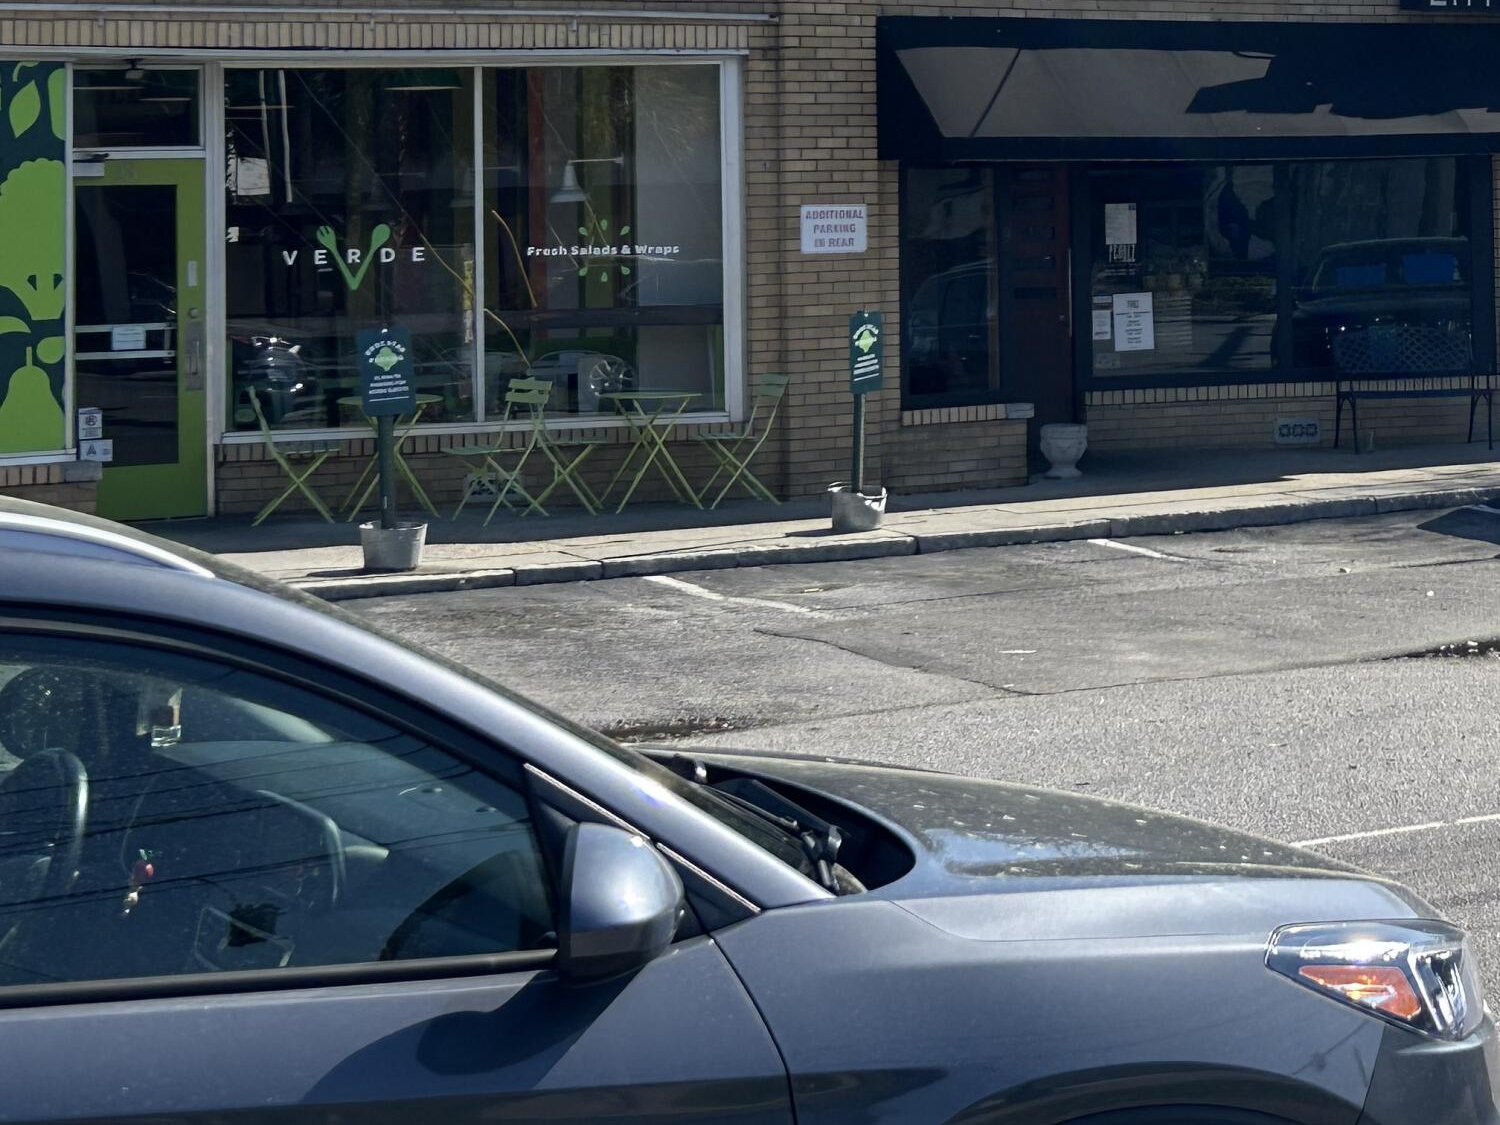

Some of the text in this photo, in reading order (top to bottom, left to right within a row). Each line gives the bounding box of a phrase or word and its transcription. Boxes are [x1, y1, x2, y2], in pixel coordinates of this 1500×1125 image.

[805, 209, 864, 220] ADDITIONAL
[813, 223, 857, 234] PARKING
[828, 237, 855, 248] REAR
[282, 246, 426, 266] VERDE
[571, 244, 618, 256] Salads
[620, 244, 631, 256] &
[634, 244, 681, 257] Wraps
